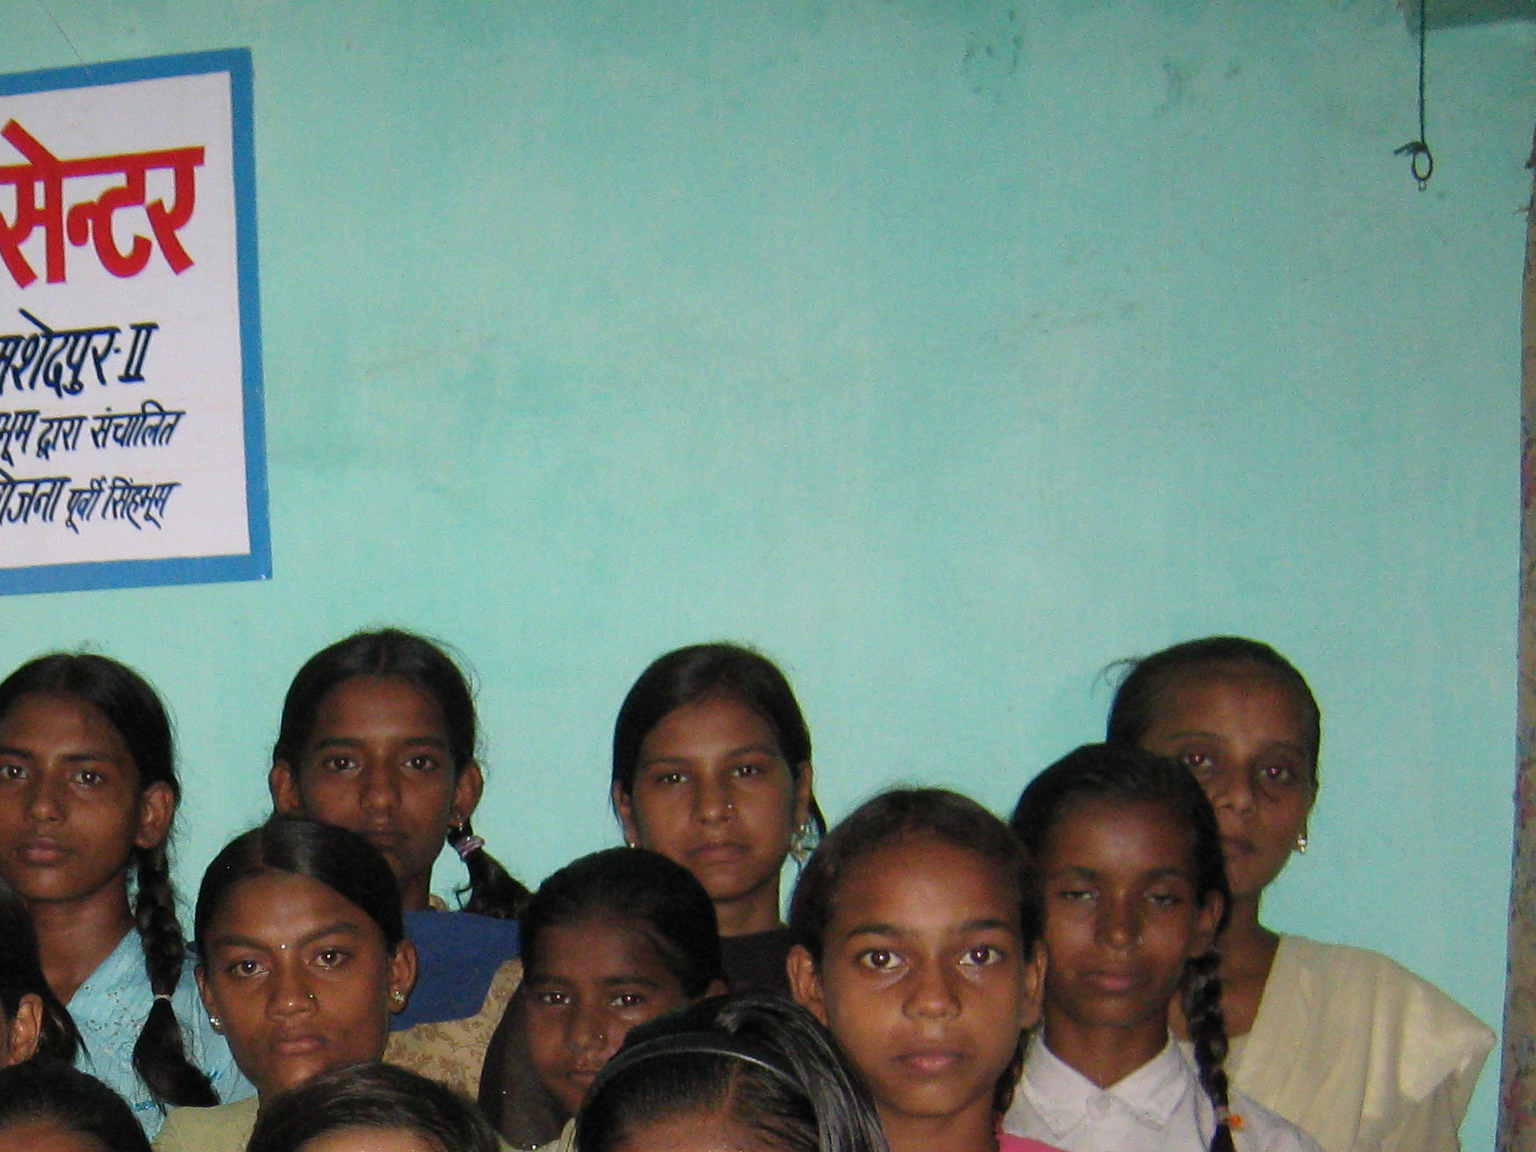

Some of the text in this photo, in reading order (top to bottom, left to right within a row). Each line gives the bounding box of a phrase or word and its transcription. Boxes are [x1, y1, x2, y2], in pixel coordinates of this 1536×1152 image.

[36, 415, 89, 460] द्वारा
[90, 400, 186, 448] संचालित
[101, 476, 182, 530] सिंहभूम
